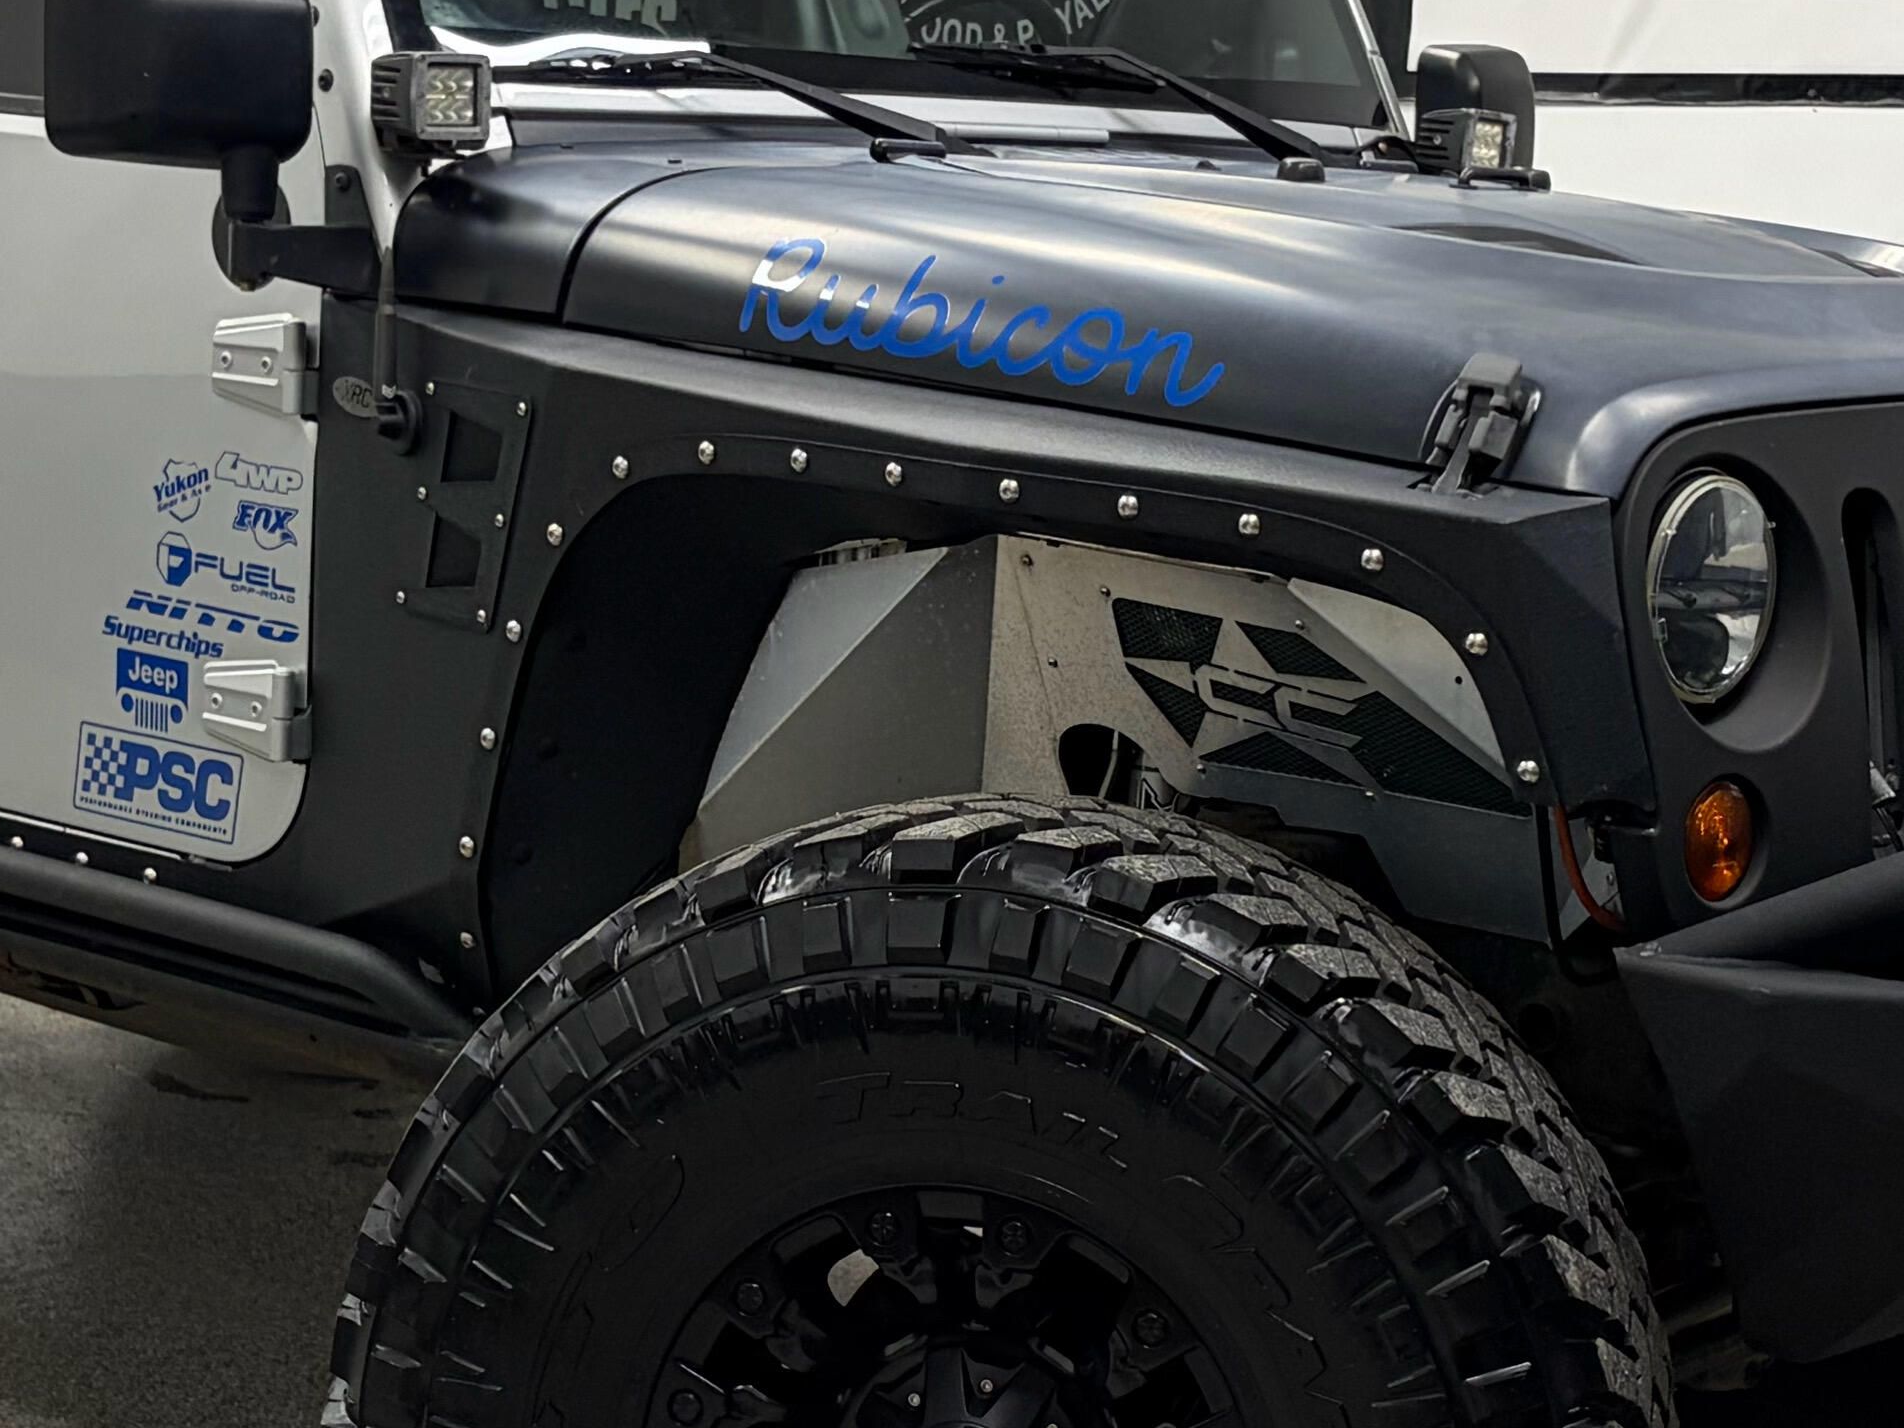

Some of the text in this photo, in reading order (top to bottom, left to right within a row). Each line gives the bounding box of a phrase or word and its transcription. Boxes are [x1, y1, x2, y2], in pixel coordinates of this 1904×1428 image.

[739, 238, 1225, 406] Rubicon
[153, 468, 209, 502] Yukon
[215, 452, 304, 495] 4WP
[232, 500, 299, 535] FOX
[194, 552, 296, 594] FUEL
[231, 583, 296, 604] OFF-ROAD
[102, 614, 224, 659] Superchips
[126, 589, 300, 643] NITTO
[128, 656, 179, 694] Jeep
[113, 739, 234, 821] PSC
